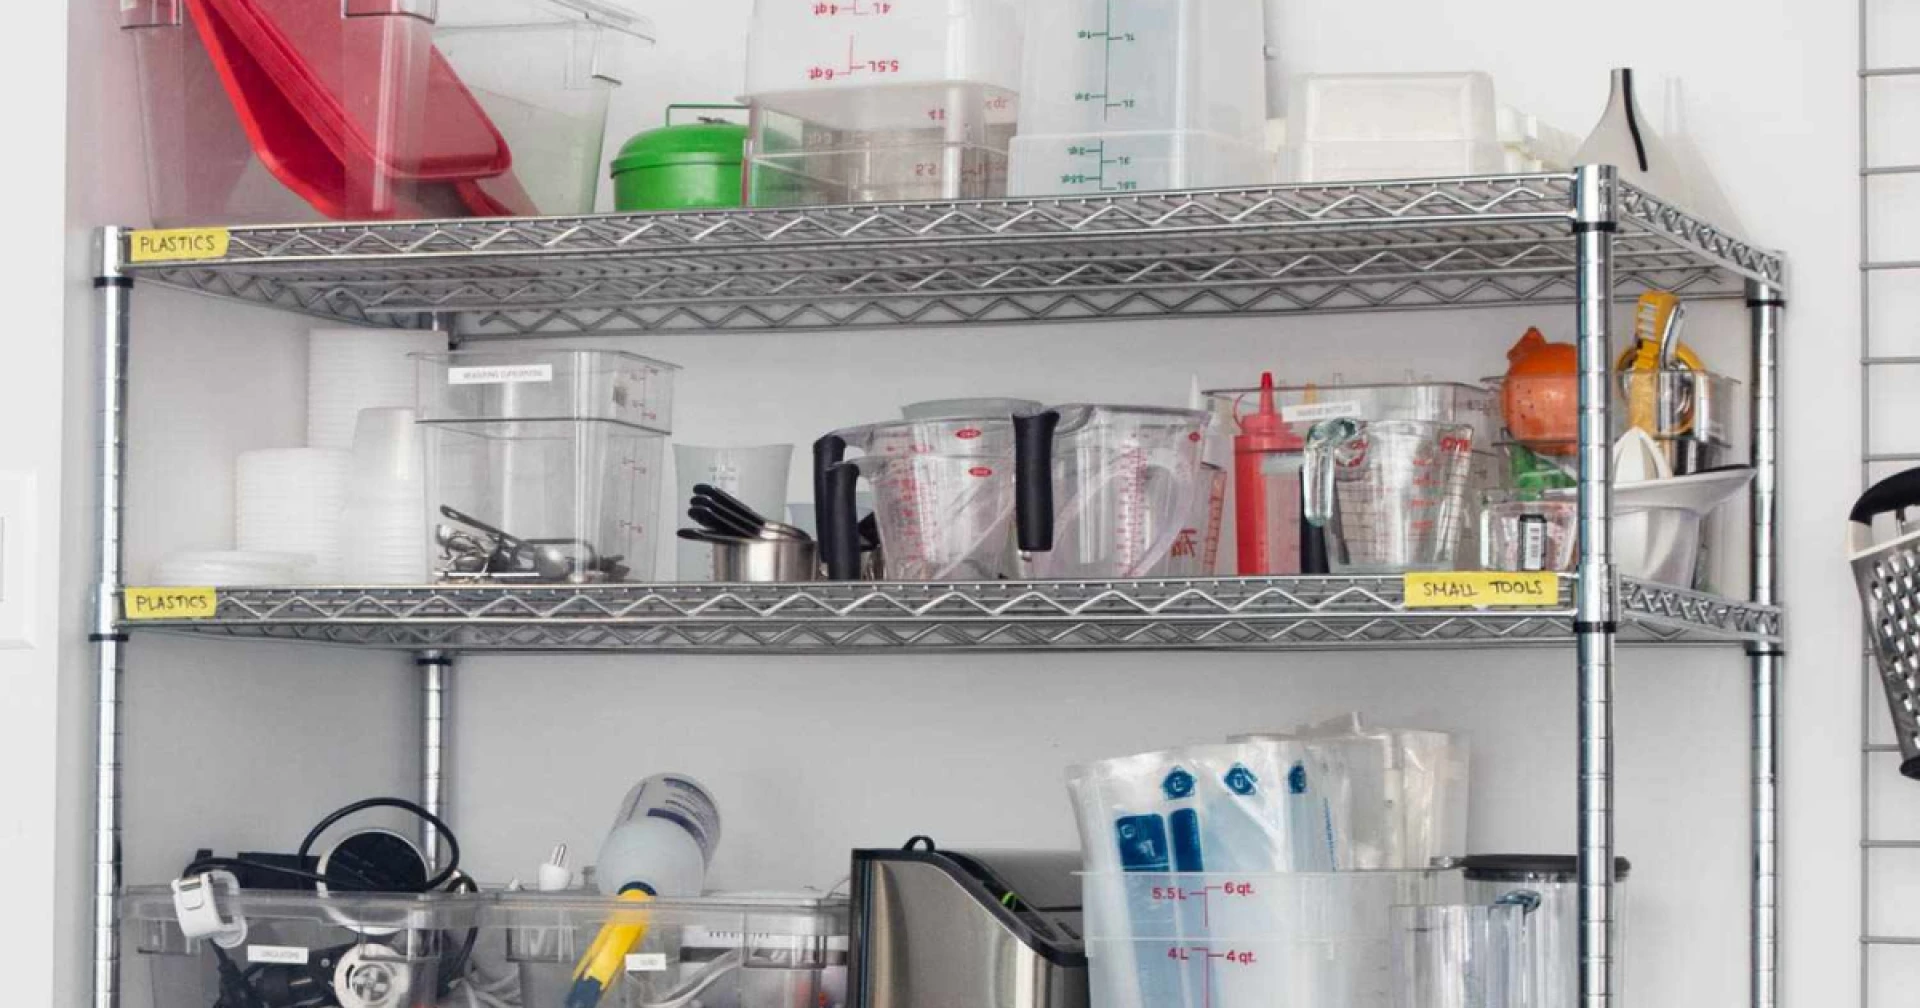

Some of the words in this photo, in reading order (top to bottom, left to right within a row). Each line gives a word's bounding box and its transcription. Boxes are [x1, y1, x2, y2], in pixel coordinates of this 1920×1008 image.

[140, 235, 215, 253] PLASTICS
[1423, 582, 1478, 597] SMALL
[1488, 580, 1543, 595] TOOLS
[136, 595, 208, 612] PLASTICS
[1224, 881, 1234, 894] 6
[1226, 949, 1236, 962] 4
